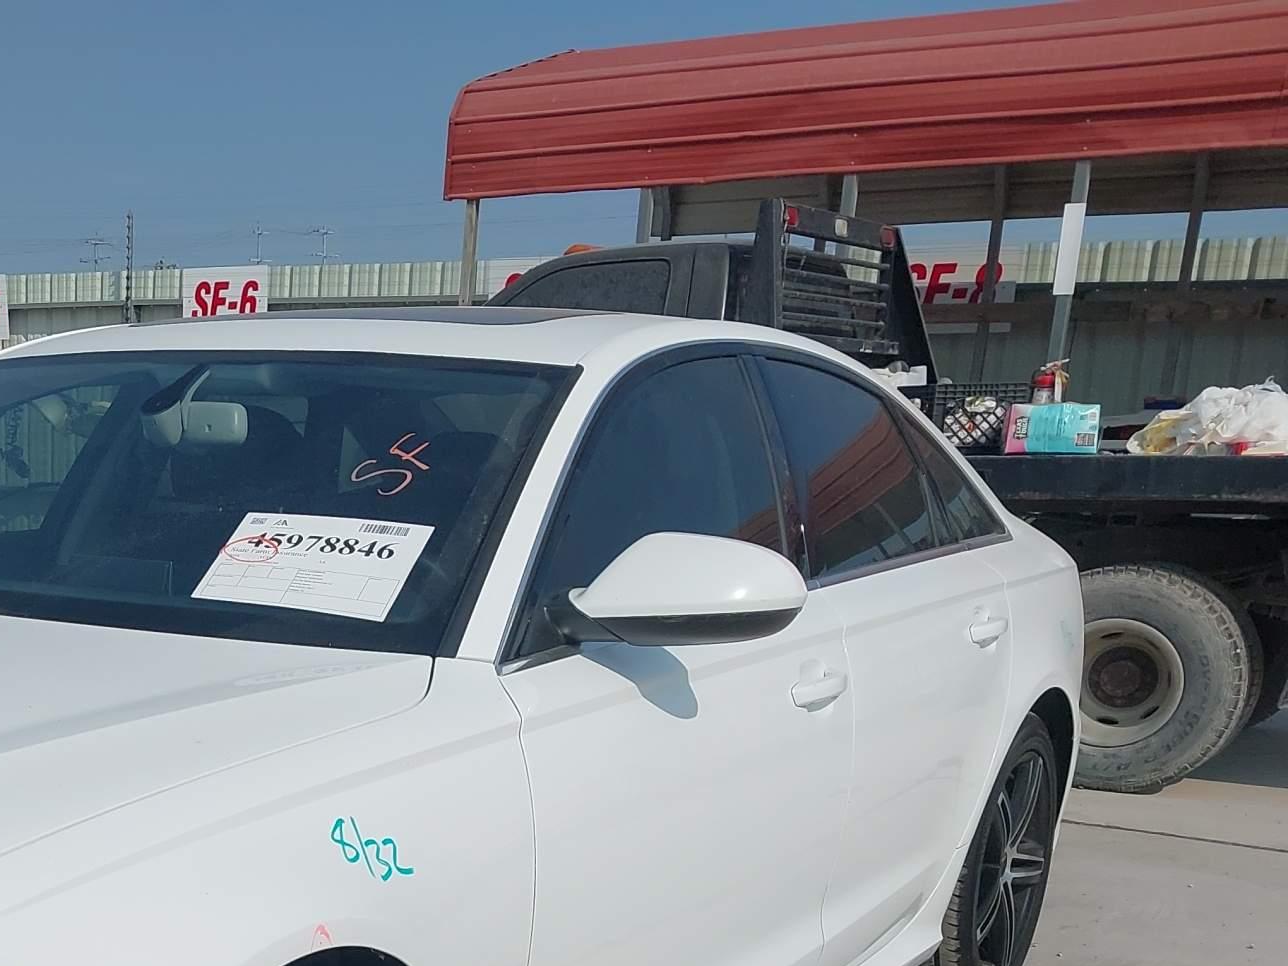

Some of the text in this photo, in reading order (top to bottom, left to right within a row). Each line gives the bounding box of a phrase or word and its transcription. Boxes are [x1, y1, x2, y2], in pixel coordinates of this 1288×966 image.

[192, 280, 258, 317] SF-6
[248, 532, 400, 559] 45978846
[331, 816, 414, 881] 8/32
